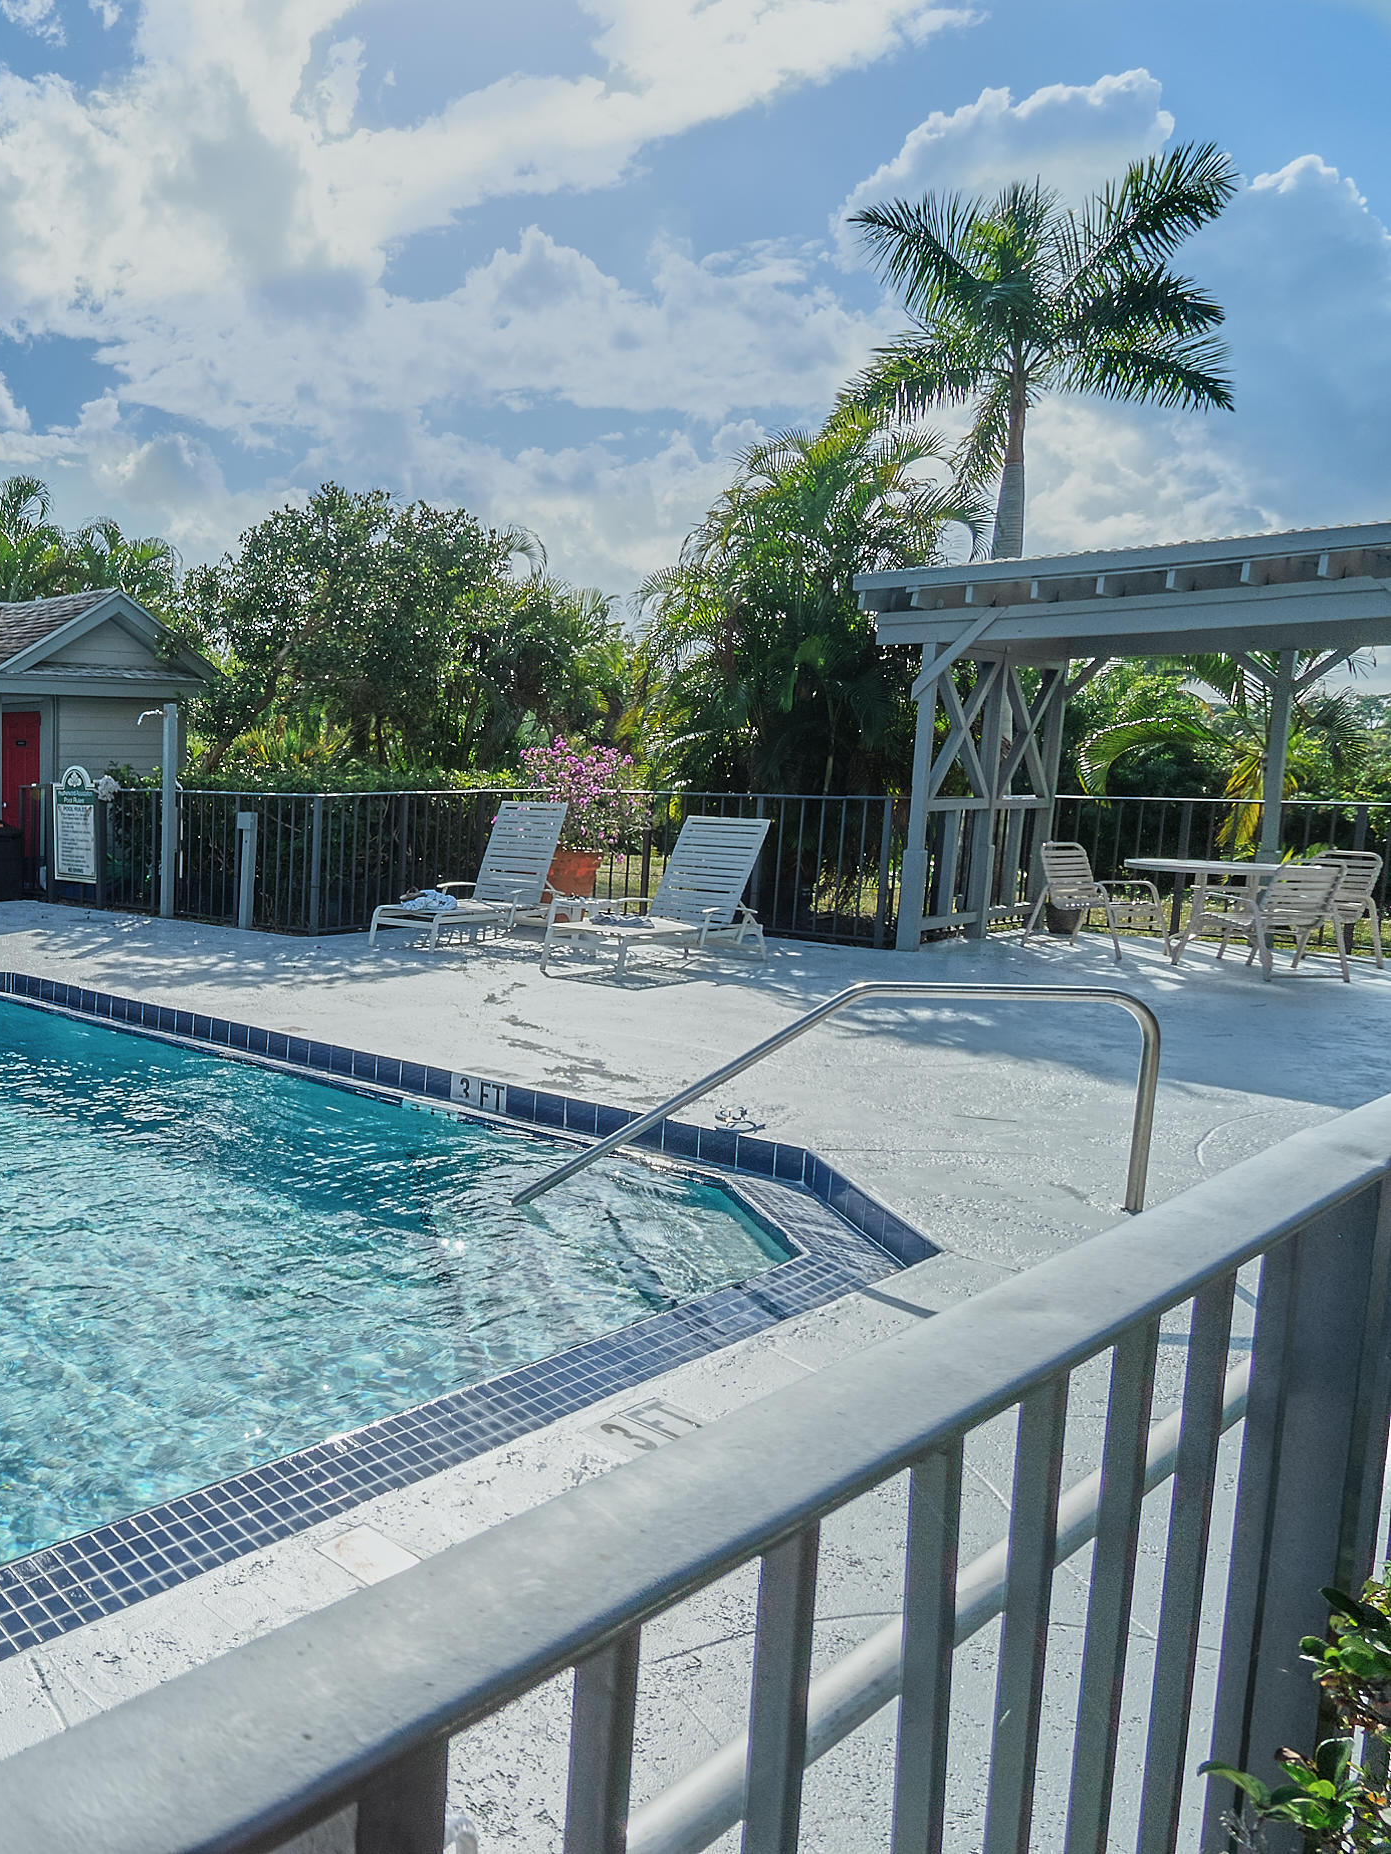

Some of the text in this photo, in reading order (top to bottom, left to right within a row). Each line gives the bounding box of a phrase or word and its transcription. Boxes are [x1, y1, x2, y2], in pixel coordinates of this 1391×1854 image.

[458, 1078, 505, 1112] 3 FT
[600, 1400, 703, 1451] 3 FT
